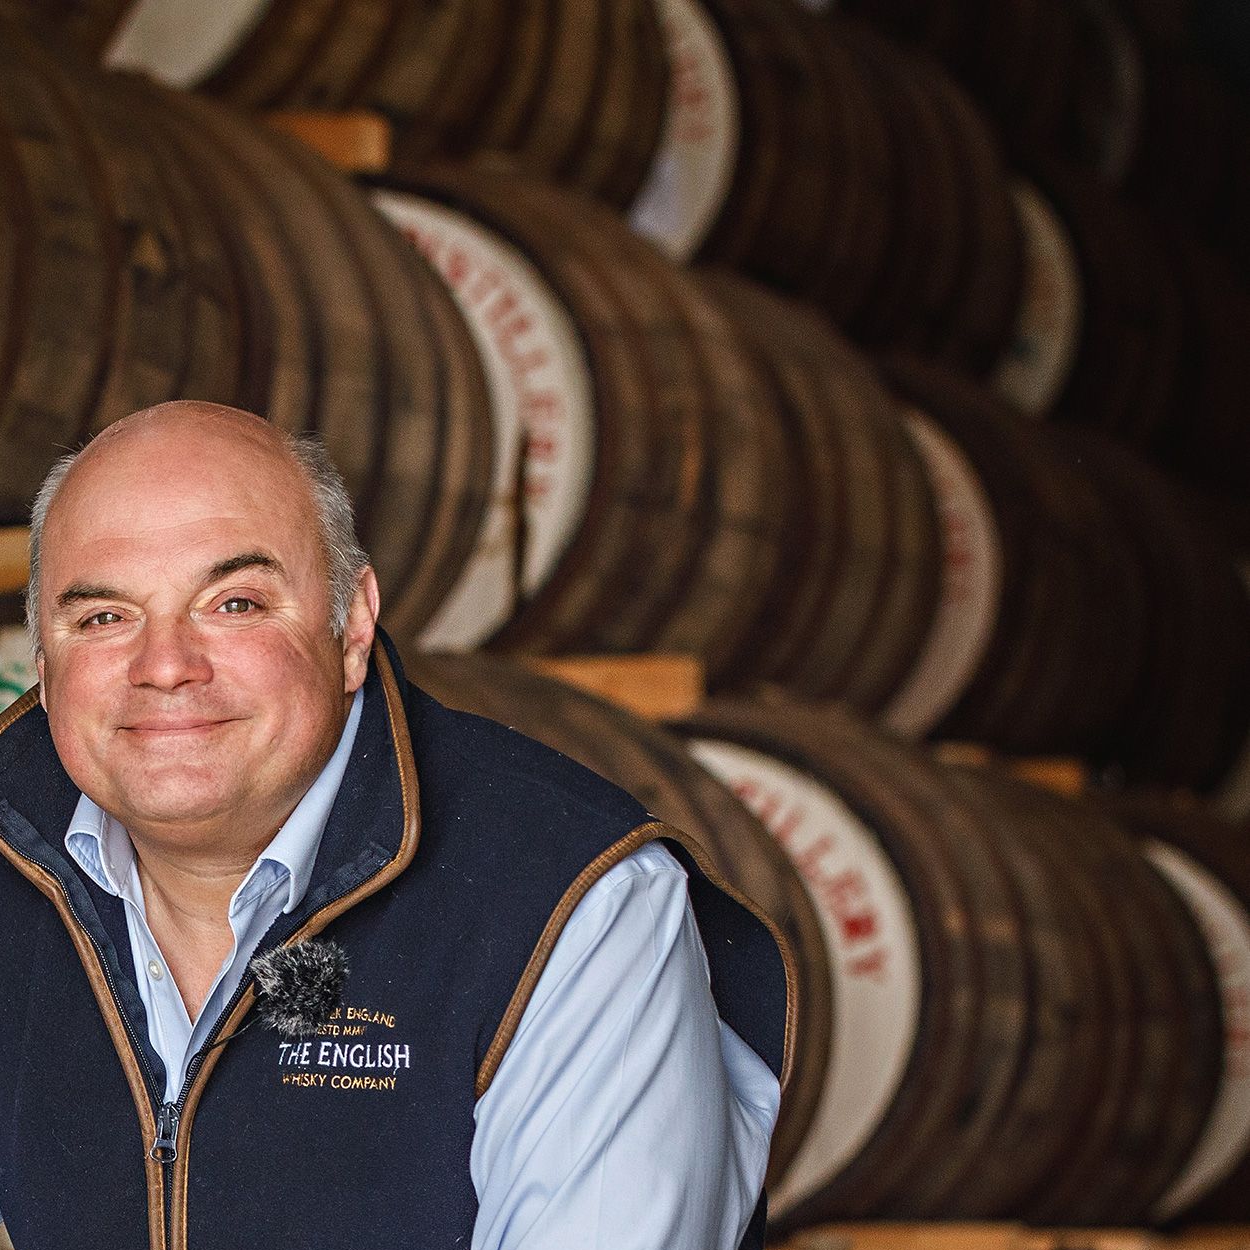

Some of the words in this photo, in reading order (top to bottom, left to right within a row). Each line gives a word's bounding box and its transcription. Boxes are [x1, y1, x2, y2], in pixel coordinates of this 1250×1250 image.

[346, 1007, 396, 1029] ENGLAND
[278, 1041, 312, 1065] THE
[317, 1041, 410, 1069] ENGLISH
[282, 1073, 327, 1087] WHISKY
[331, 1074, 397, 1090] COMPANY
